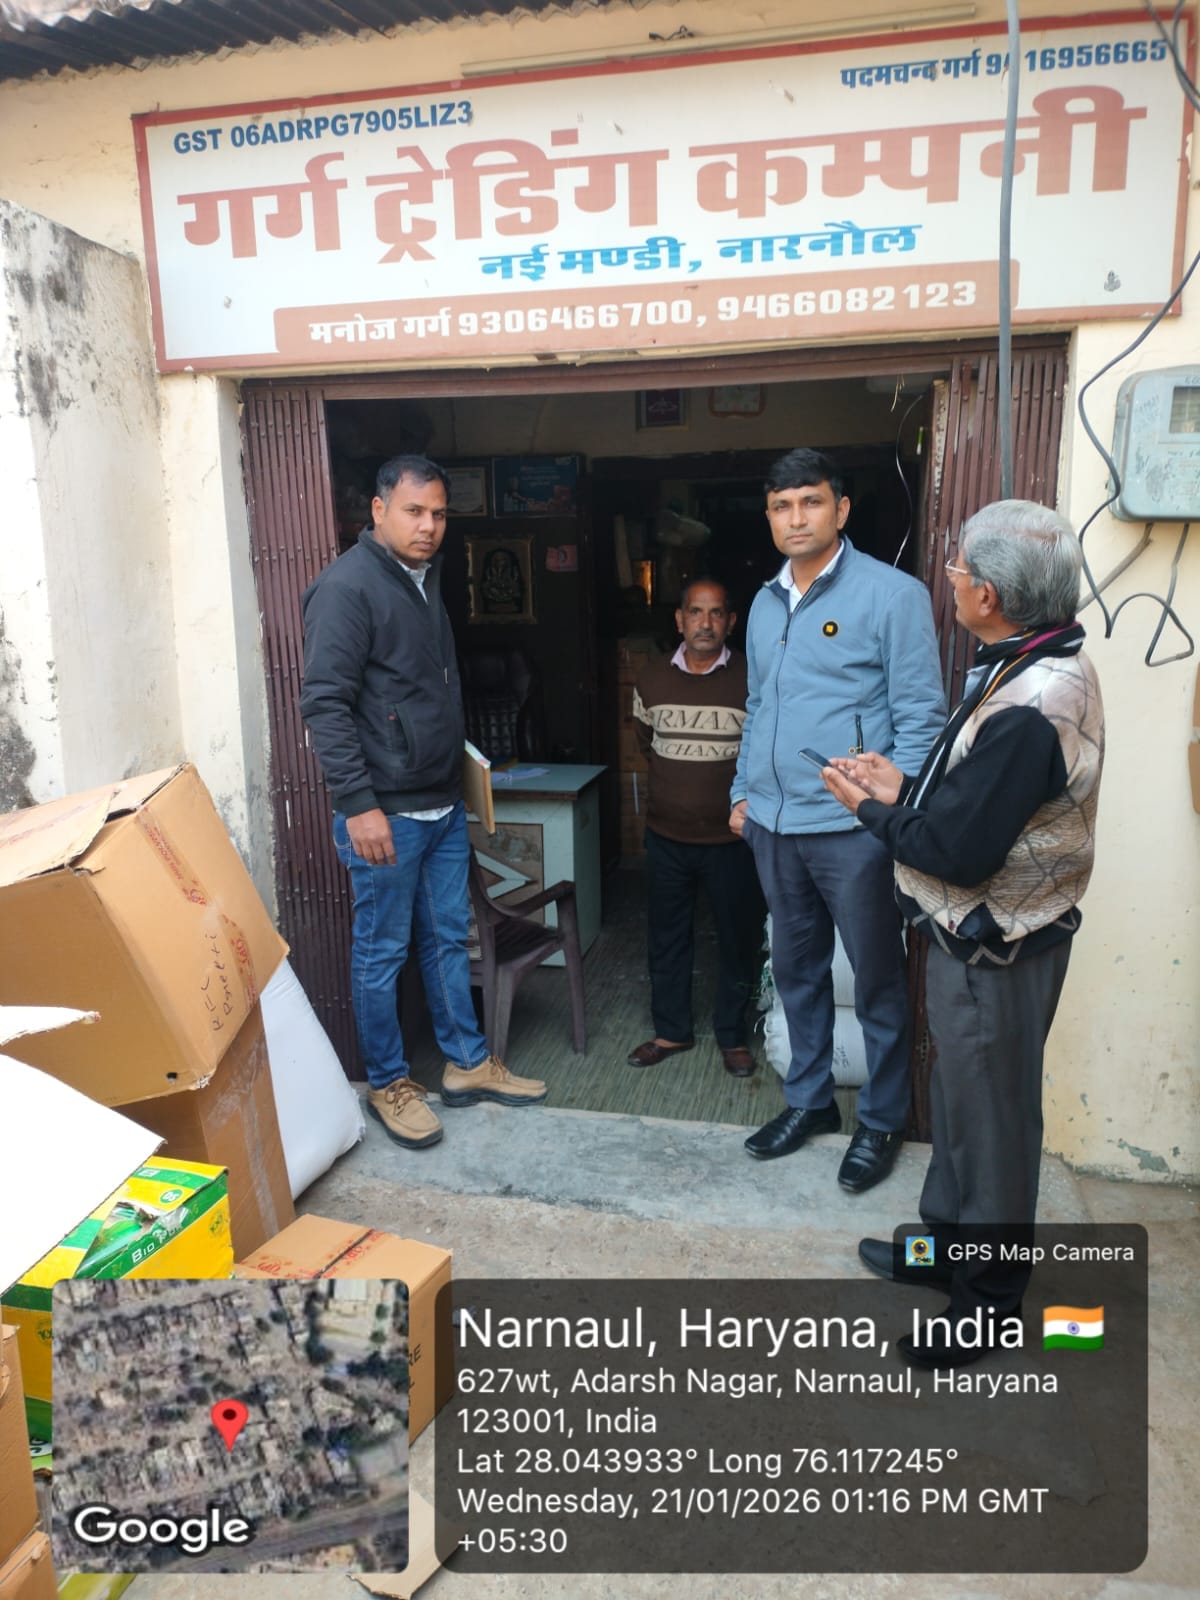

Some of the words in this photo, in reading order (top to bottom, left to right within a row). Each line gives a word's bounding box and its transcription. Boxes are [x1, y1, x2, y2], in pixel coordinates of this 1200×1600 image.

[942, 48, 982, 79] गर्ग
[173, 128, 222, 154] GST
[231, 101, 473, 147] 06ADRPG7905LIZ3
[176, 151, 348, 259] गर्ग
[366, 128, 669, 264] ट्रेडिंग
[688, 84, 1148, 219] कम्पनी
[478, 242, 551, 281] नई
[558, 235, 702, 278] मण्डी,
[717, 220, 923, 264] नारनौल
[308, 312, 398, 343] मनोज
[401, 306, 452, 338] गर्ग
[458, 297, 707, 337] 9306466700,
[717, 280, 977, 321] 9466082123
